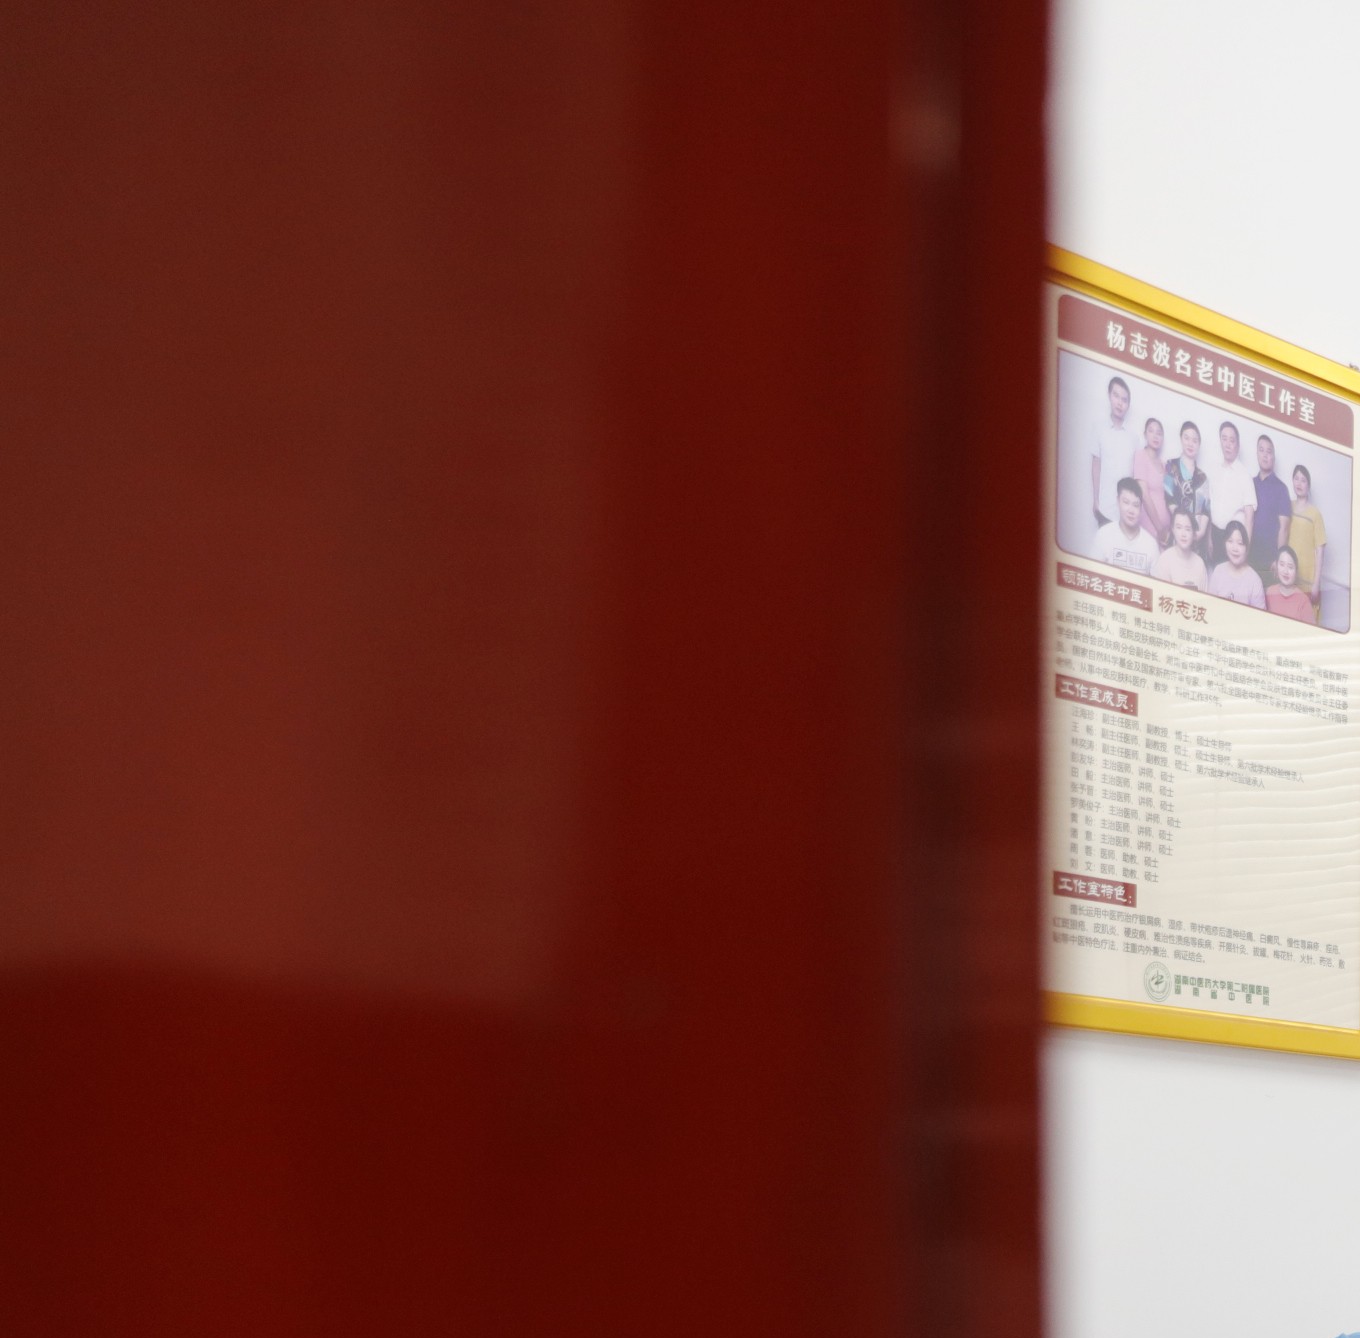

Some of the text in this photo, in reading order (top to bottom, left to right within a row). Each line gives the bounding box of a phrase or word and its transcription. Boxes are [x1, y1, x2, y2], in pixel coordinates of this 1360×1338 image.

[1105, 319, 1317, 426] 杨志波名老中医工作室
[1157, 592, 1208, 625] 杨志波
